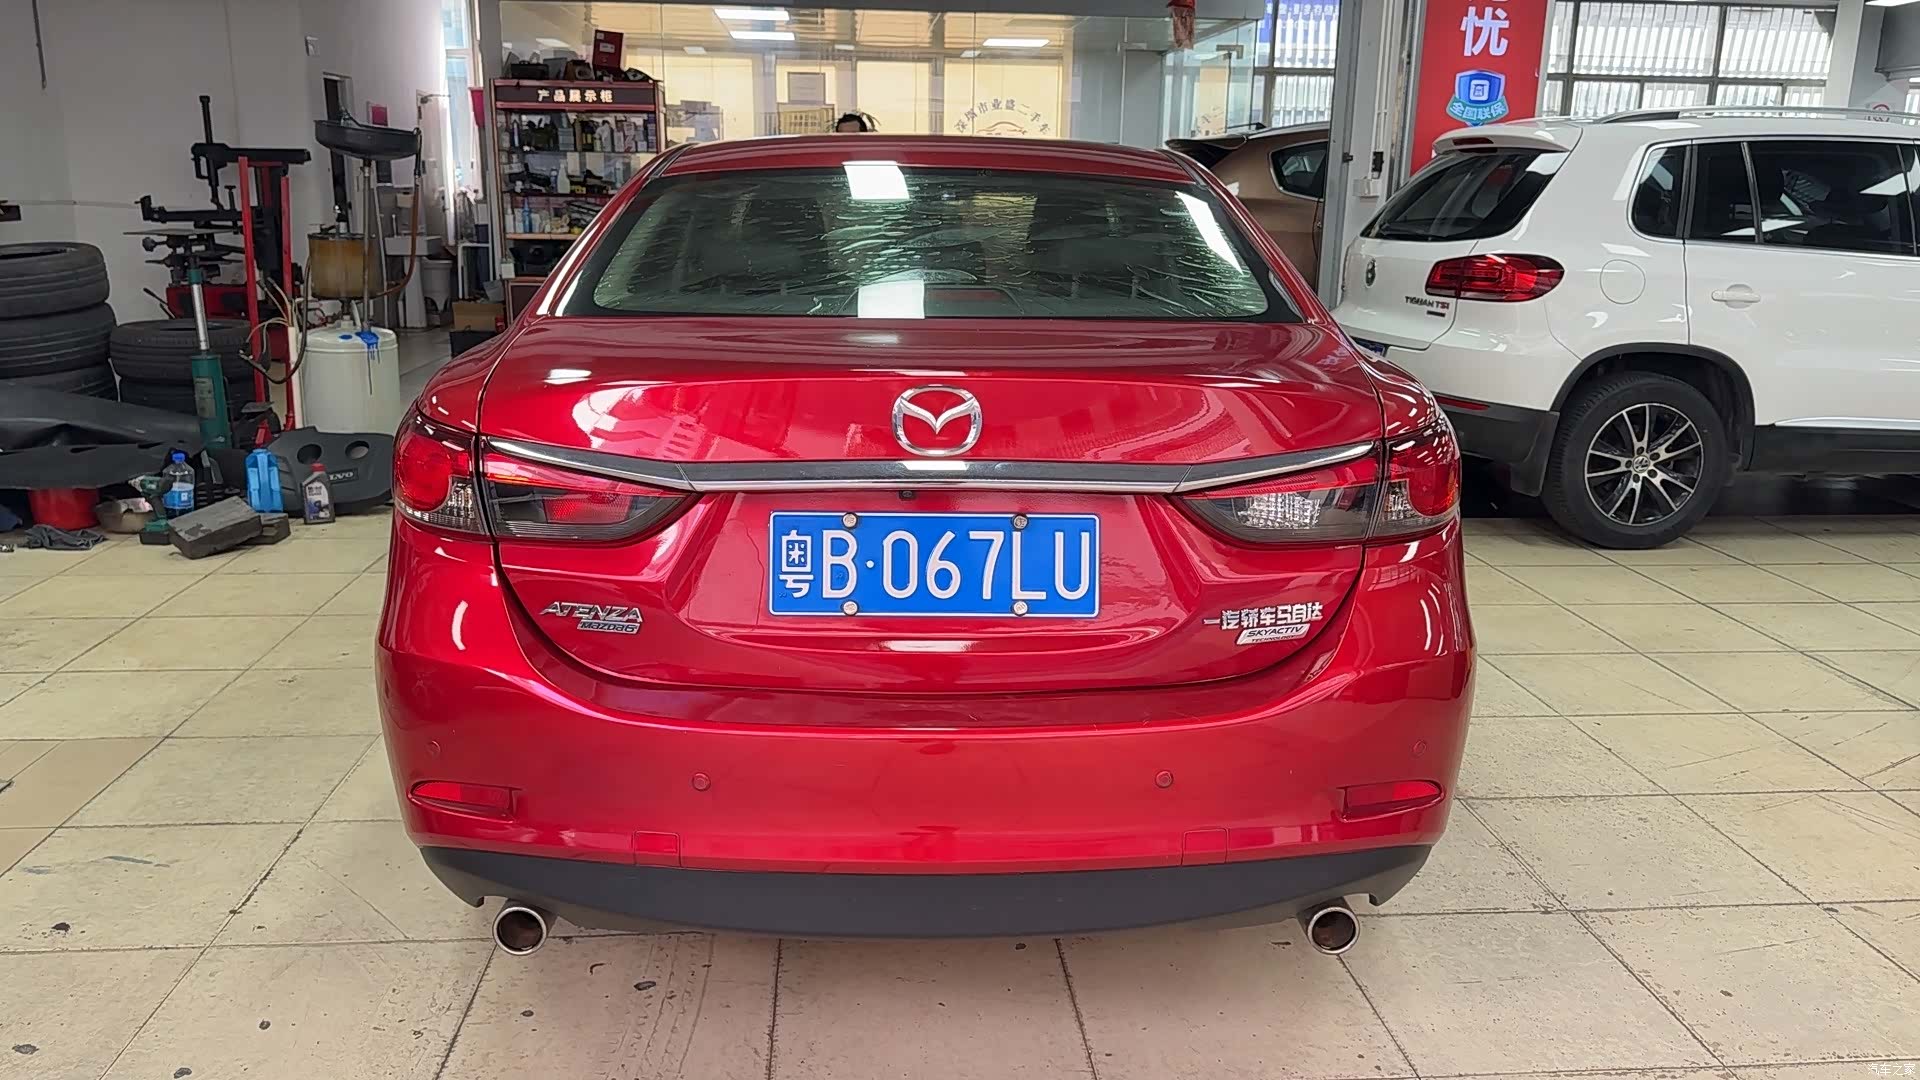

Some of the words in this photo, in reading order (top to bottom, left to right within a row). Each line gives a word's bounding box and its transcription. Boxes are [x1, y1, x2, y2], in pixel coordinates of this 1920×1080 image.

[1460, 0, 1510, 56] 忧
[537, 89, 613, 103] 产品展示柜
[1449, 101, 1506, 121] 全国联保
[1404, 296, 1435, 308] TIGUAN
[1435, 300, 1451, 310] TSI
[778, 529, 1091, 600] 粤B·067LU
[539, 601, 643, 623] ATENZA
[1203, 601, 1324, 631] 一汽轿车马自达
[1246, 625, 1304, 638] SKYACTIV
